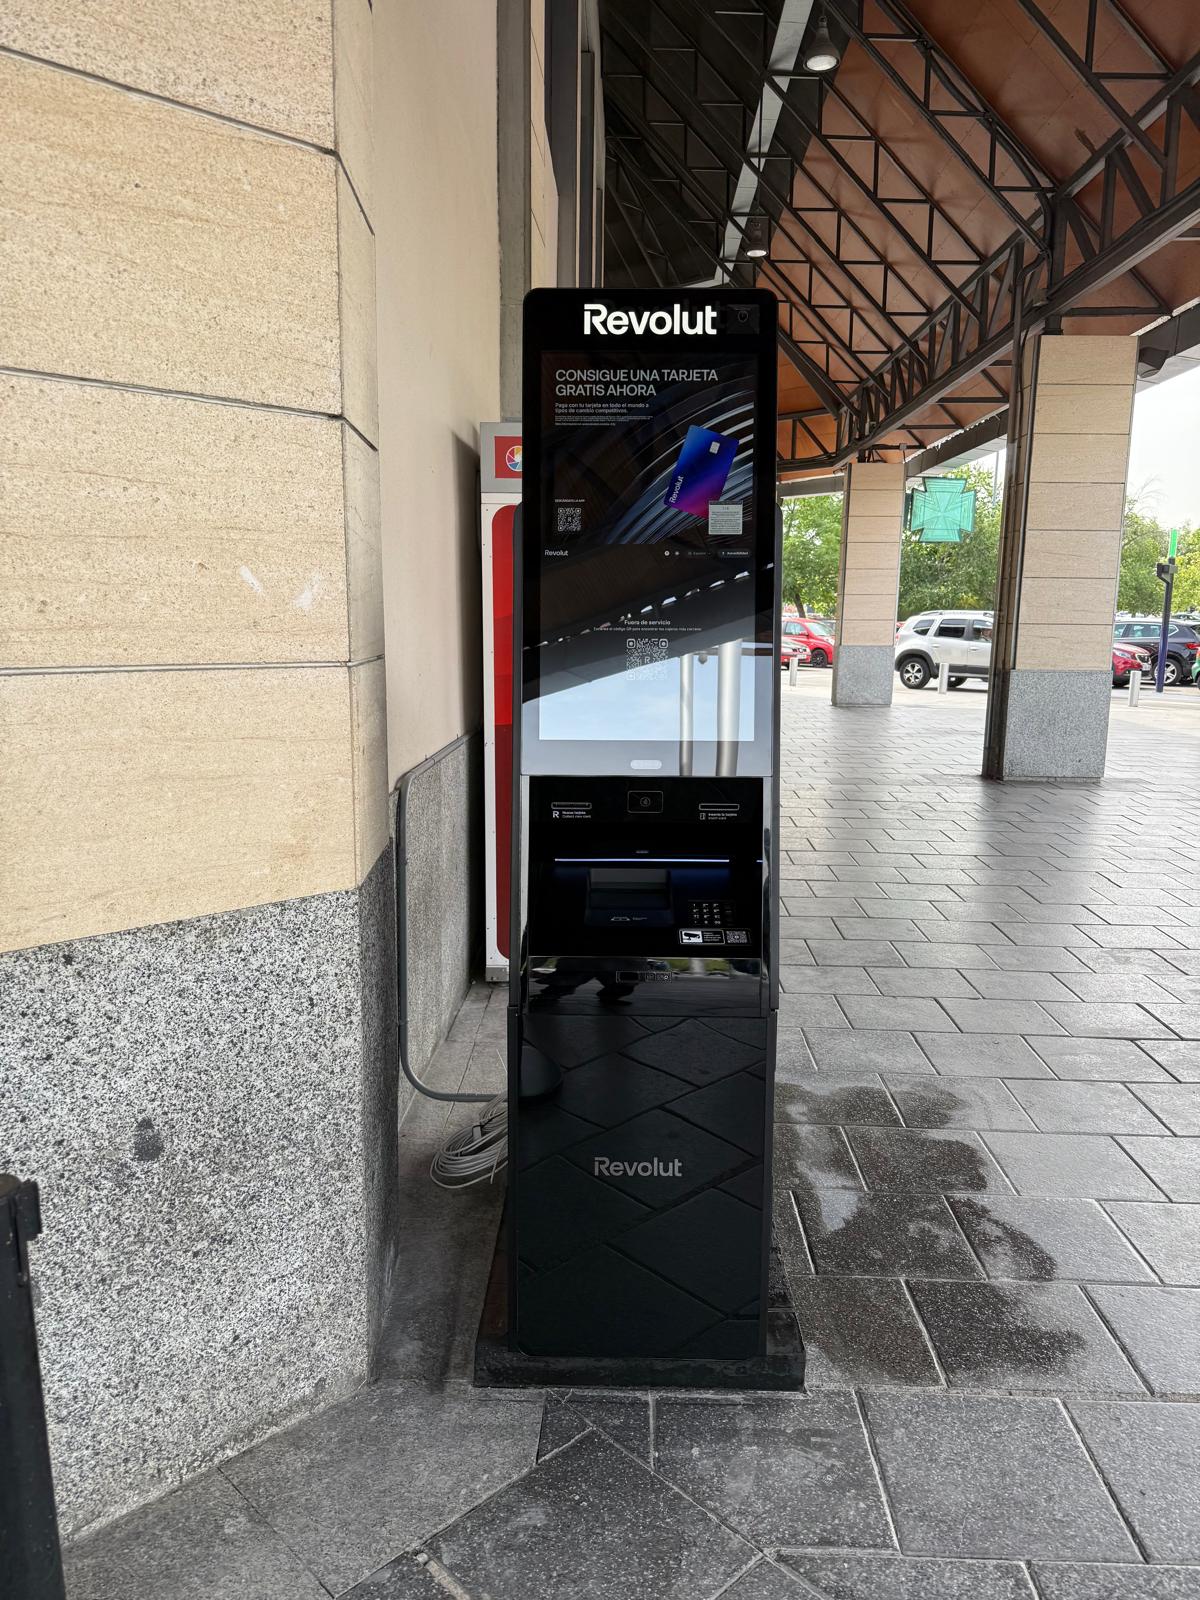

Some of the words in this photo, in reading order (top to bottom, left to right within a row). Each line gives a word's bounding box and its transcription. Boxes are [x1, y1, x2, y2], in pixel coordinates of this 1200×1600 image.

[583, 303, 718, 335] Revolut
[555, 369, 629, 382] CONSIGUE
[630, 369, 660, 382] UNA
[661, 369, 719, 382] TARJETA
[555, 384, 605, 397] GRATIS
[606, 384, 657, 397] AHORA
[668, 475, 684, 504] Revolut
[544, 549, 569, 557] Revolut
[594, 1156, 683, 1177] Revolut
